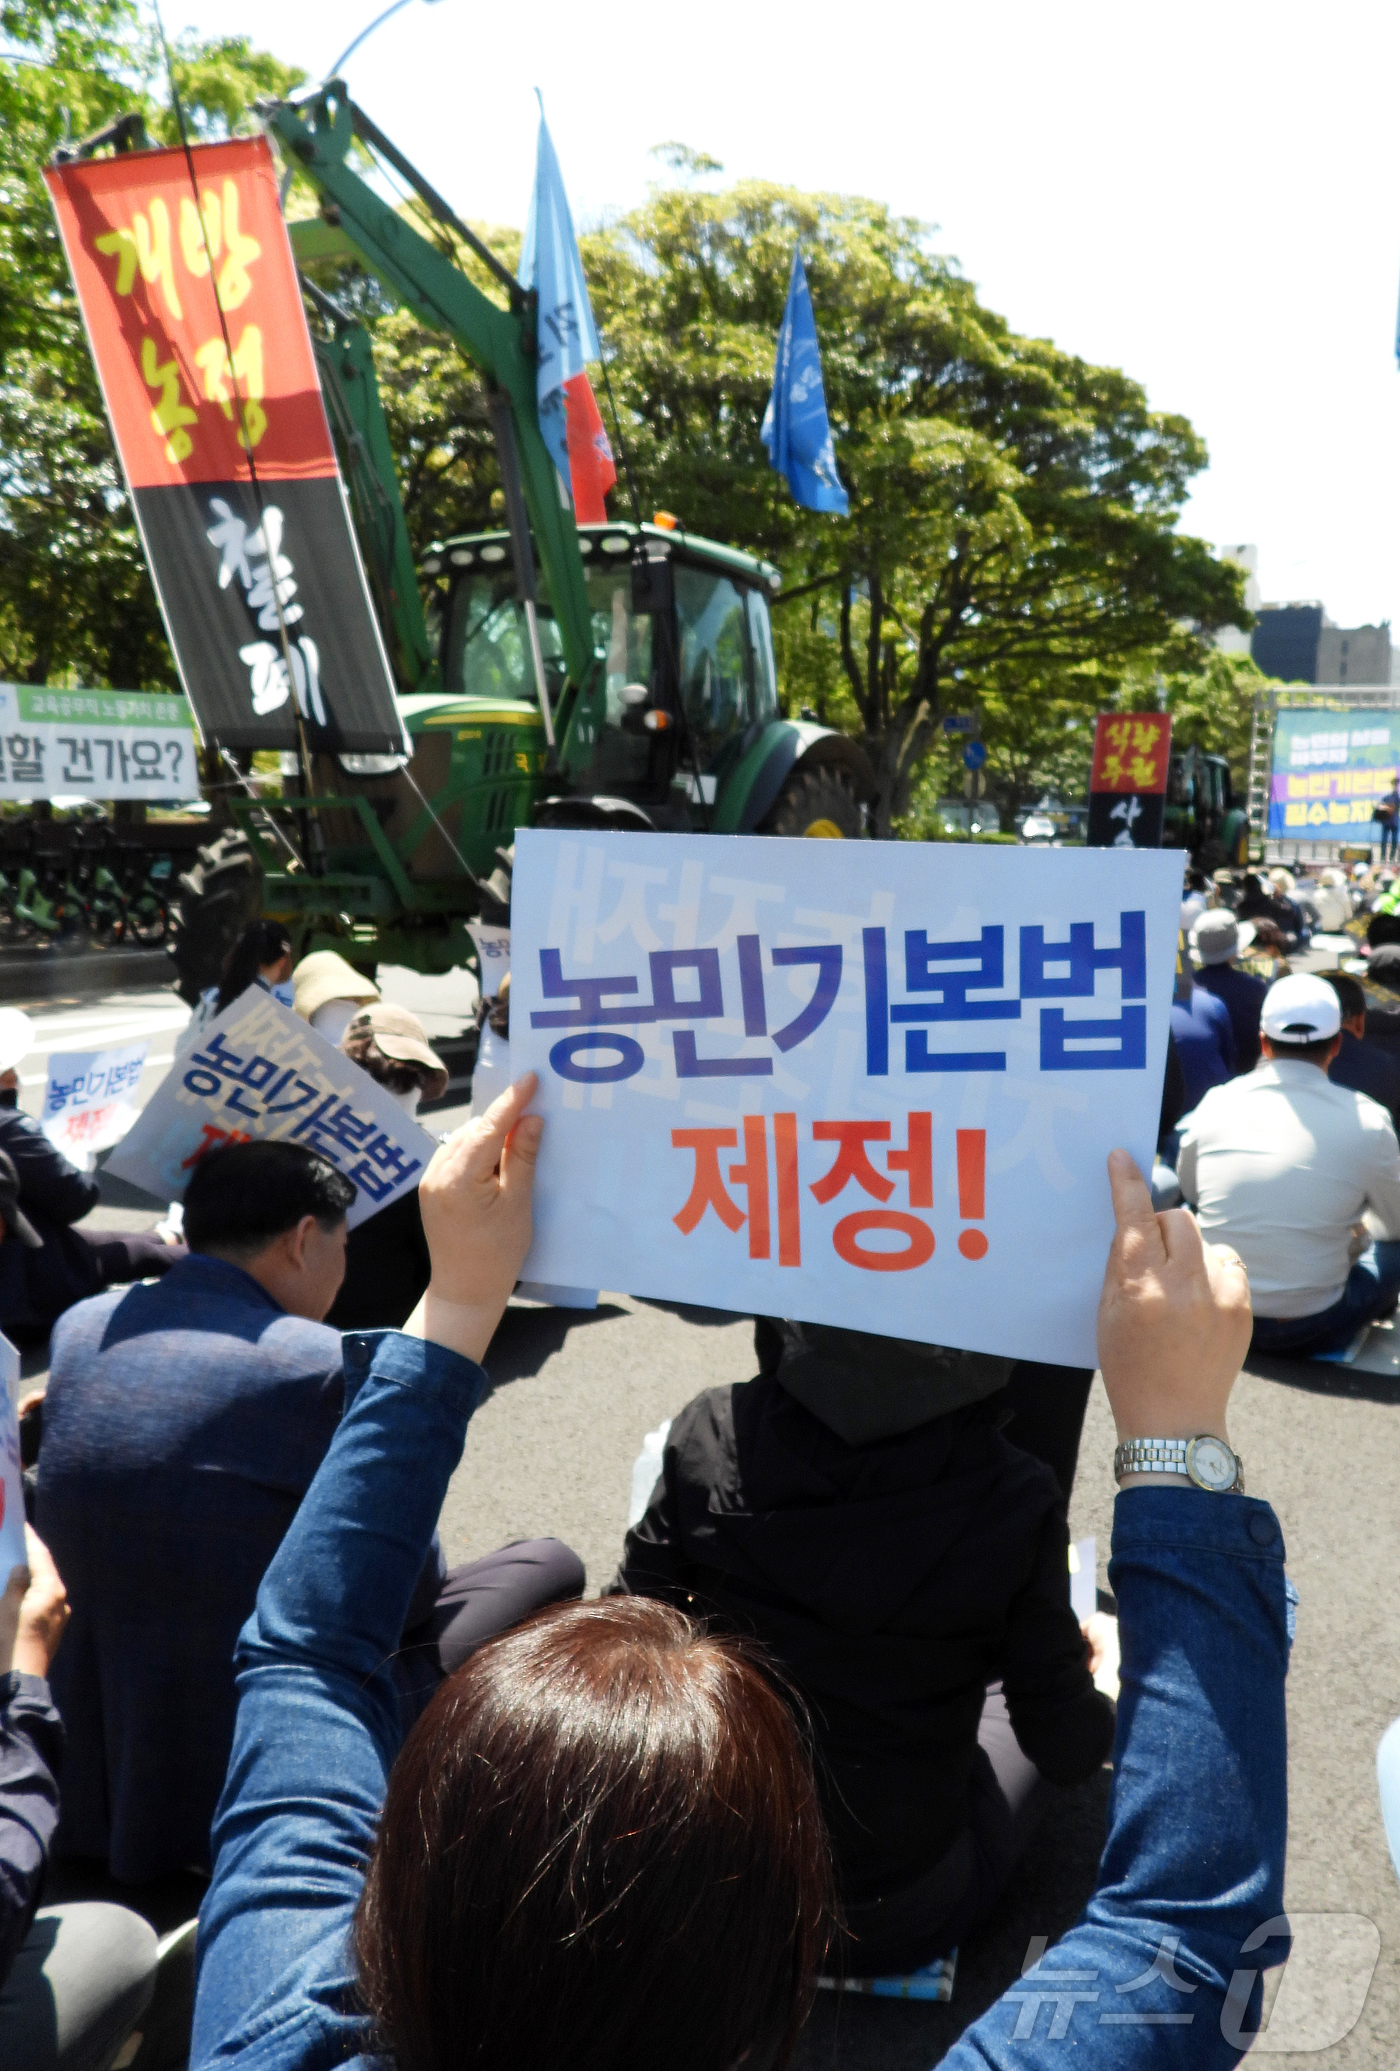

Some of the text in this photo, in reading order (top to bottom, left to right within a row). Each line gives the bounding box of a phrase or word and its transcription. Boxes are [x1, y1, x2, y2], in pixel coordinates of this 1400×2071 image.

[95, 180, 261, 320] 개방
[141, 323, 267, 464] 농정
[207, 498, 327, 727] 철폐
[57, 736, 184, 784] 건가요?
[530, 911, 1147, 1083] 농민기본법
[183, 1033, 422, 1202] 농민기본법
[671, 1111, 989, 1272] 제정!
